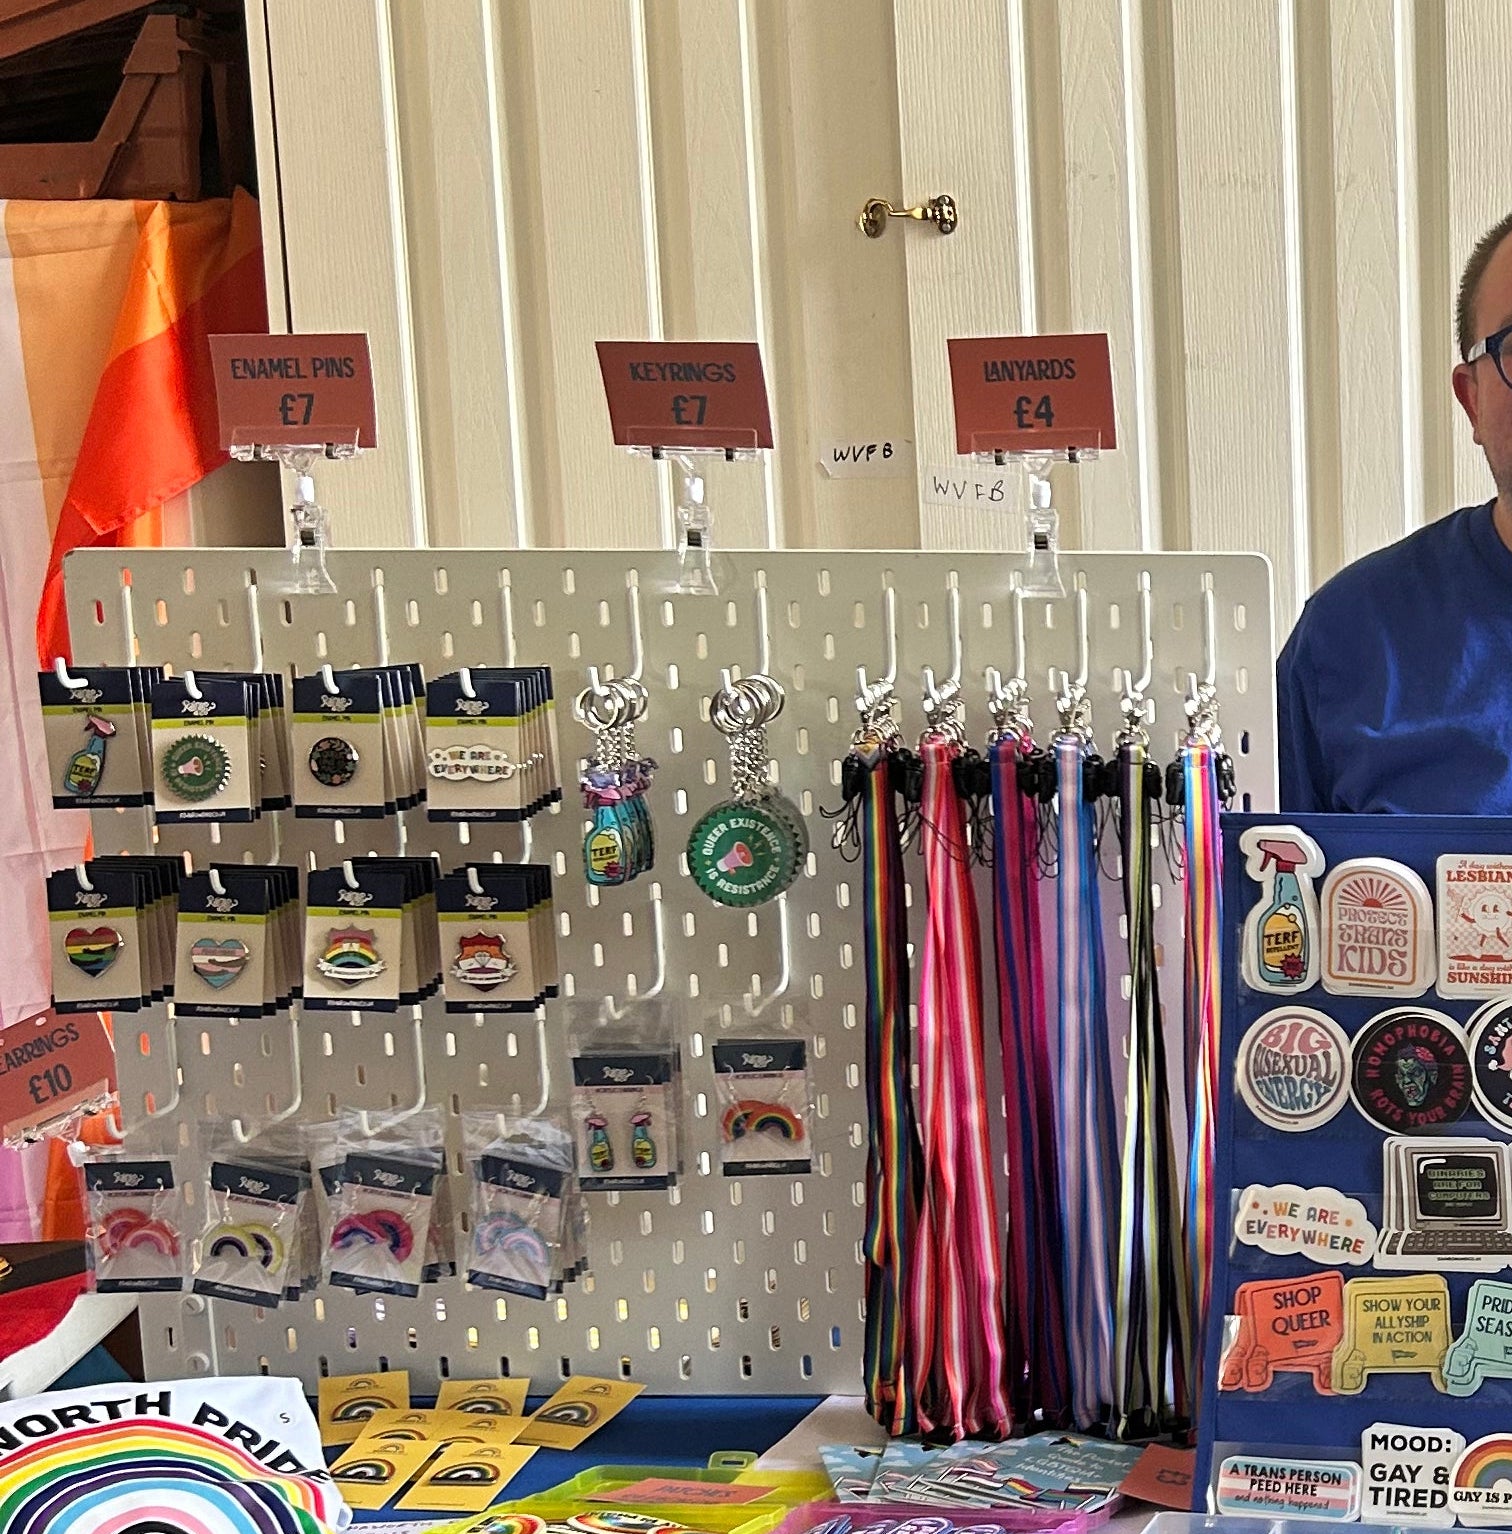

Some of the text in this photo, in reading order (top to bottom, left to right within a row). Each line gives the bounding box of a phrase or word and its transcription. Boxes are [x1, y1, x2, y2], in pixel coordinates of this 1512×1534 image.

[231, 357, 355, 380] ENAMEL PINS
[629, 362, 736, 383] KEYRINGS
[983, 358, 1076, 383] LANYARDS
[279, 393, 314, 426] £7
[672, 395, 707, 425] £7
[1014, 395, 1054, 428] £4
[832, 442, 894, 463] WVFB
[932, 476, 1005, 502] WVFB
[449, 752, 464, 760] WE
[434, 764, 510, 775] EVERYWHERE
[1338, 908, 1408, 926] PROTECT
[1264, 931, 1299, 945] TERF
[1339, 923, 1408, 947] TRANS
[1337, 944, 1408, 977] KIDS
[1261, 1023, 1332, 1054] BIG
[30, 1063, 72, 1104] £10
[1256, 1077, 1332, 1111] ENERGY
[1273, 1203, 1339, 1225] WE ARE
[1246, 1220, 1365, 1255] EVERYWHERE
[1273, 1287, 1322, 1310] SHOP
[1362, 1298, 1441, 1313] SHOW YOUR
[1271, 1312, 1330, 1336] QUEER
[1374, 1315, 1429, 1329] ALLYSHIP
[1387, 1330, 1432, 1344] ACTION
[192, 1402, 331, 1482] PRIDE
[1370, 1434, 1451, 1453] MOOD:
[1244, 1465, 1341, 1485] TRANS PERSON
[1370, 1463, 1419, 1485] GAY
[1250, 1478, 1317, 1497] PEED HERE
[1368, 1487, 1447, 1509] TIRED
[1454, 1490, 1481, 1503] GAY
